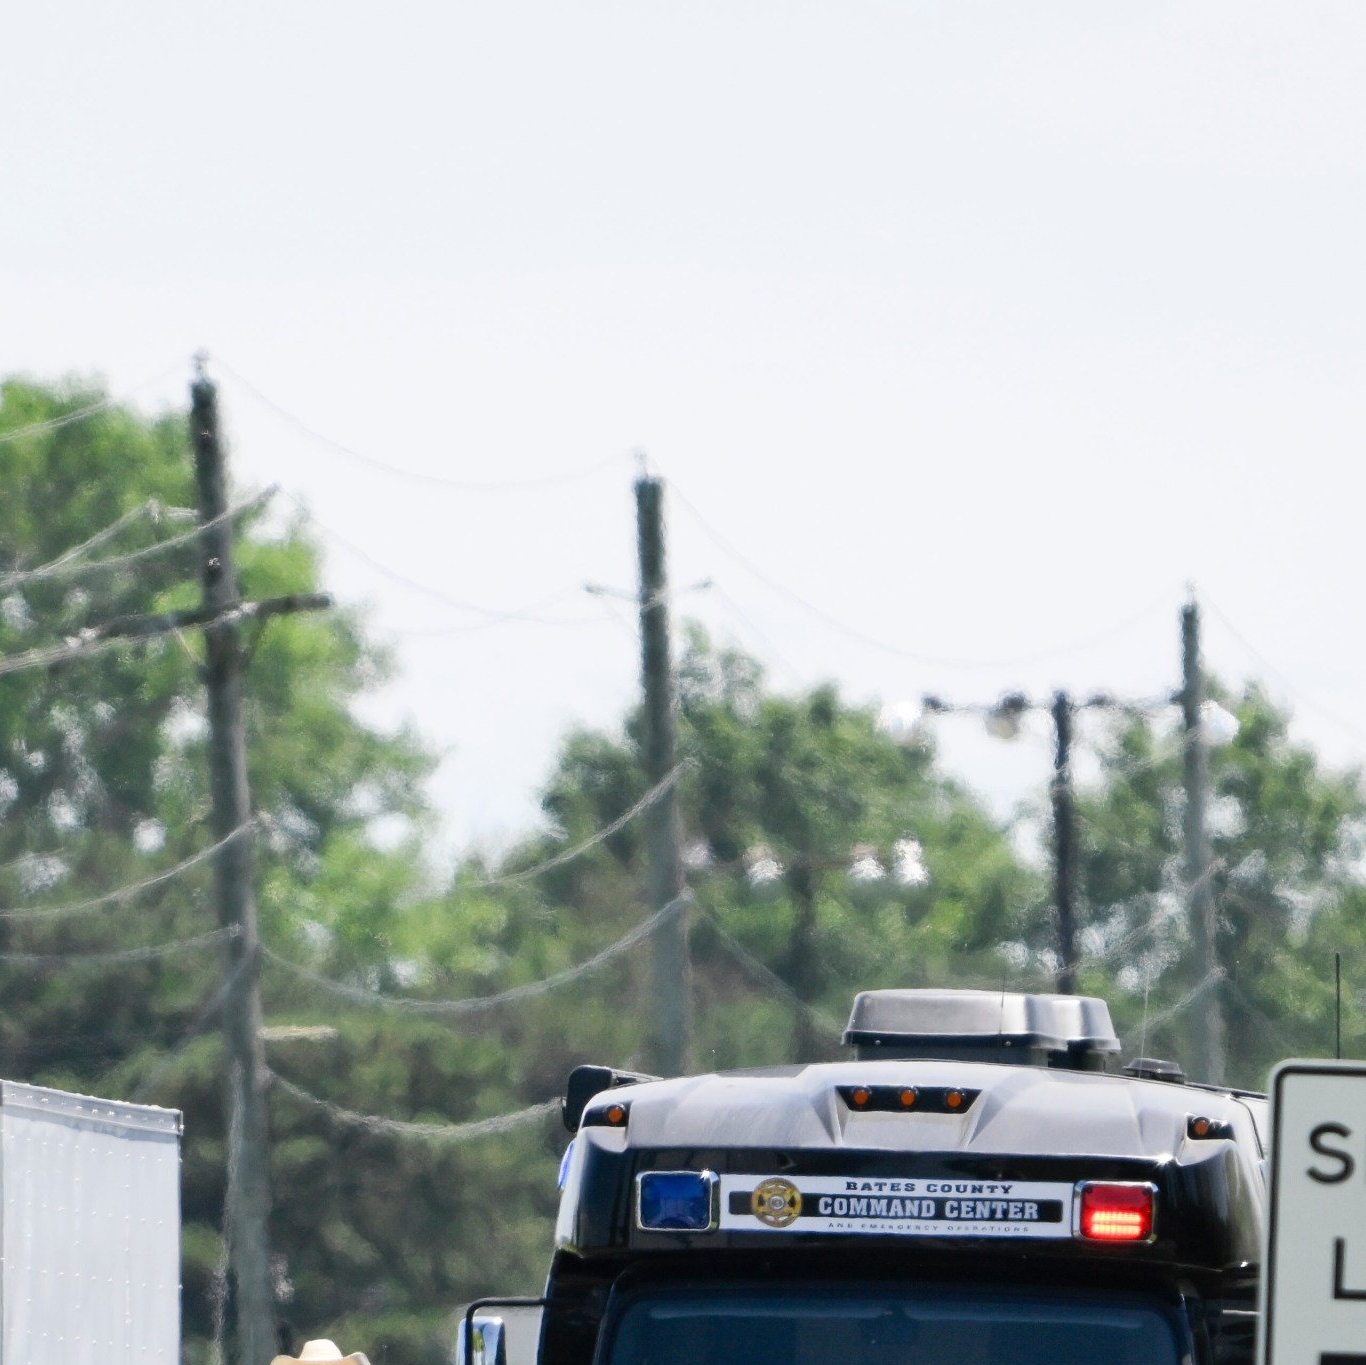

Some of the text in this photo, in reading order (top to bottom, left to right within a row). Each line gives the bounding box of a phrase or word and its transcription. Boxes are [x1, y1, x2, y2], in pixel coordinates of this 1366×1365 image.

[845, 1180, 1014, 1195] BATES COUNTY
[818, 1196, 1039, 1220] COMMAND CENTER
[861, 1223, 938, 1231] EMERGENCY
